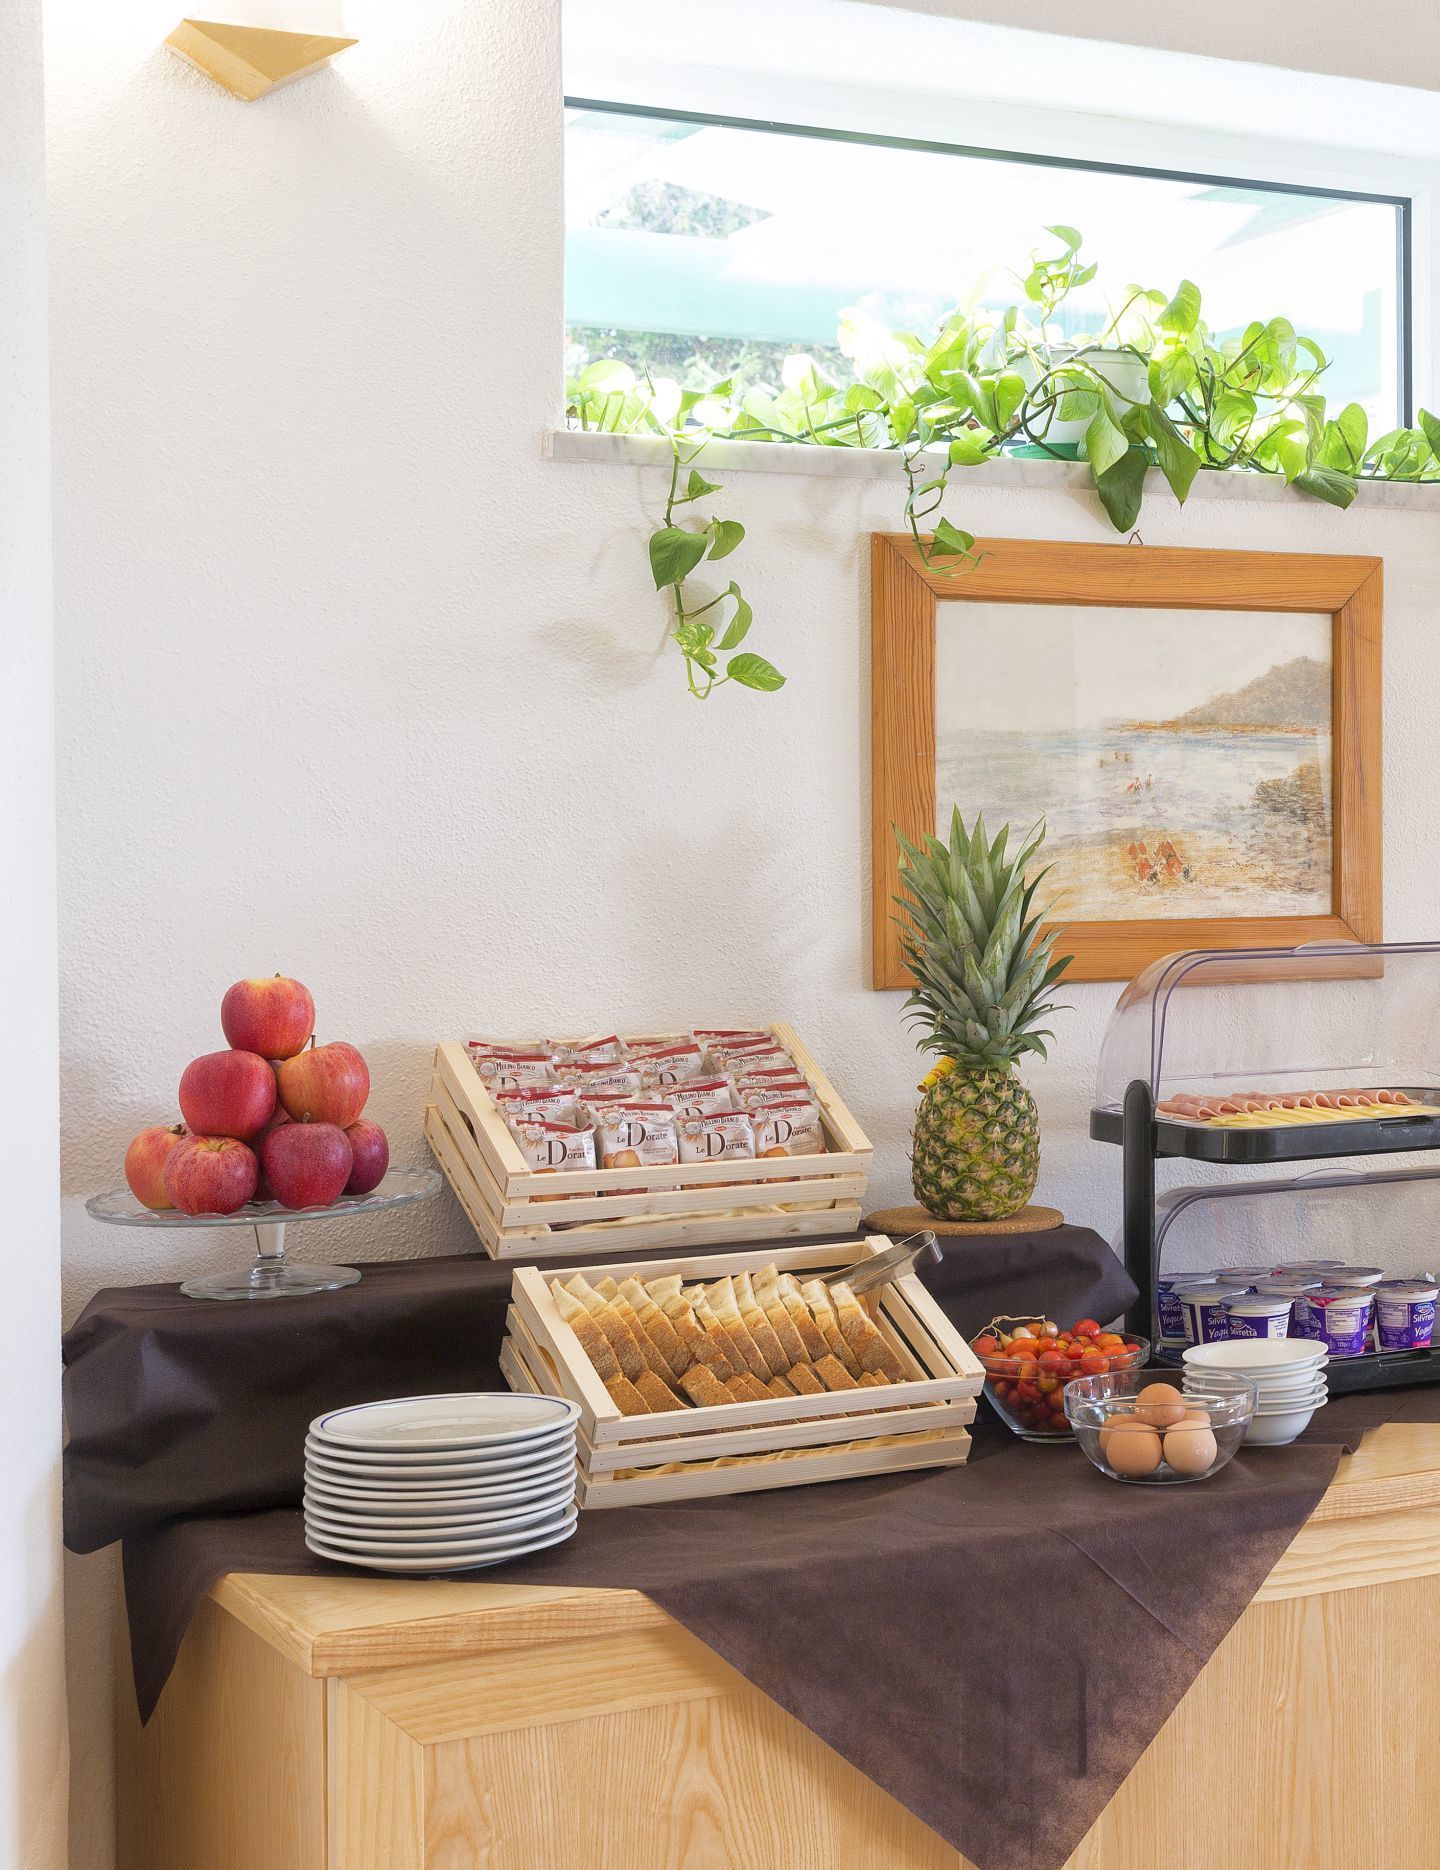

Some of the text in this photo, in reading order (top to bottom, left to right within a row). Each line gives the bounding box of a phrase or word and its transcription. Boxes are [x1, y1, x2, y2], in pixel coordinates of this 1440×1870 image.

[625, 1122, 668, 1147] Dorate
[765, 1119, 812, 1144] Le Dorate
[545, 1140, 586, 1165] Dorat
[704, 1132, 749, 1157] Dorate
